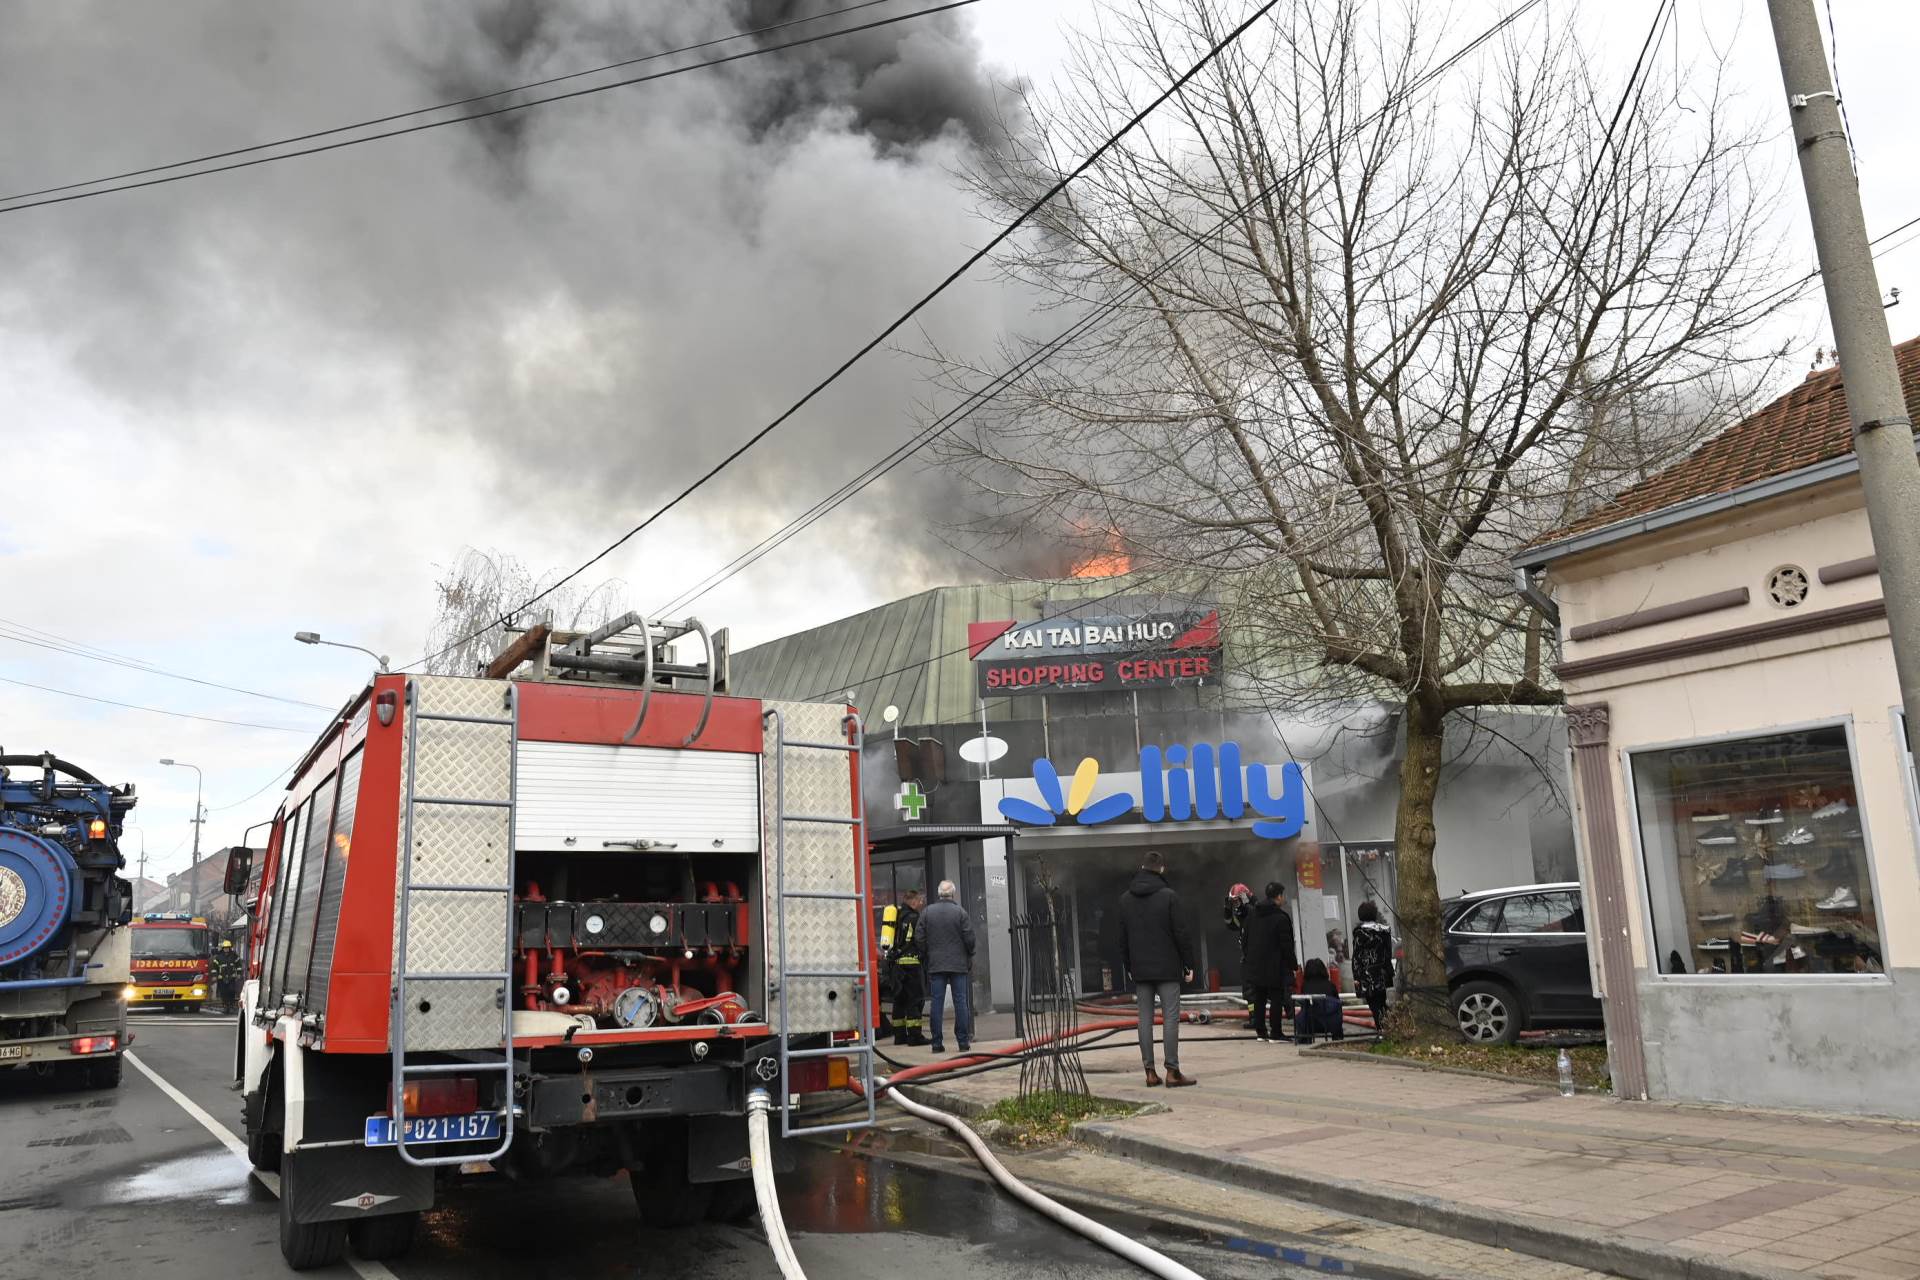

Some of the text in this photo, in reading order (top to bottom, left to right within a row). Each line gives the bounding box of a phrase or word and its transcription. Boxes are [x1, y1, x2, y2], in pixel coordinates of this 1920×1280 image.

[1004, 622, 1175, 649] KAI TAI BAI HUO
[987, 657, 1209, 687] SHOPPING CENTER
[1140, 741, 1305, 839] lilly
